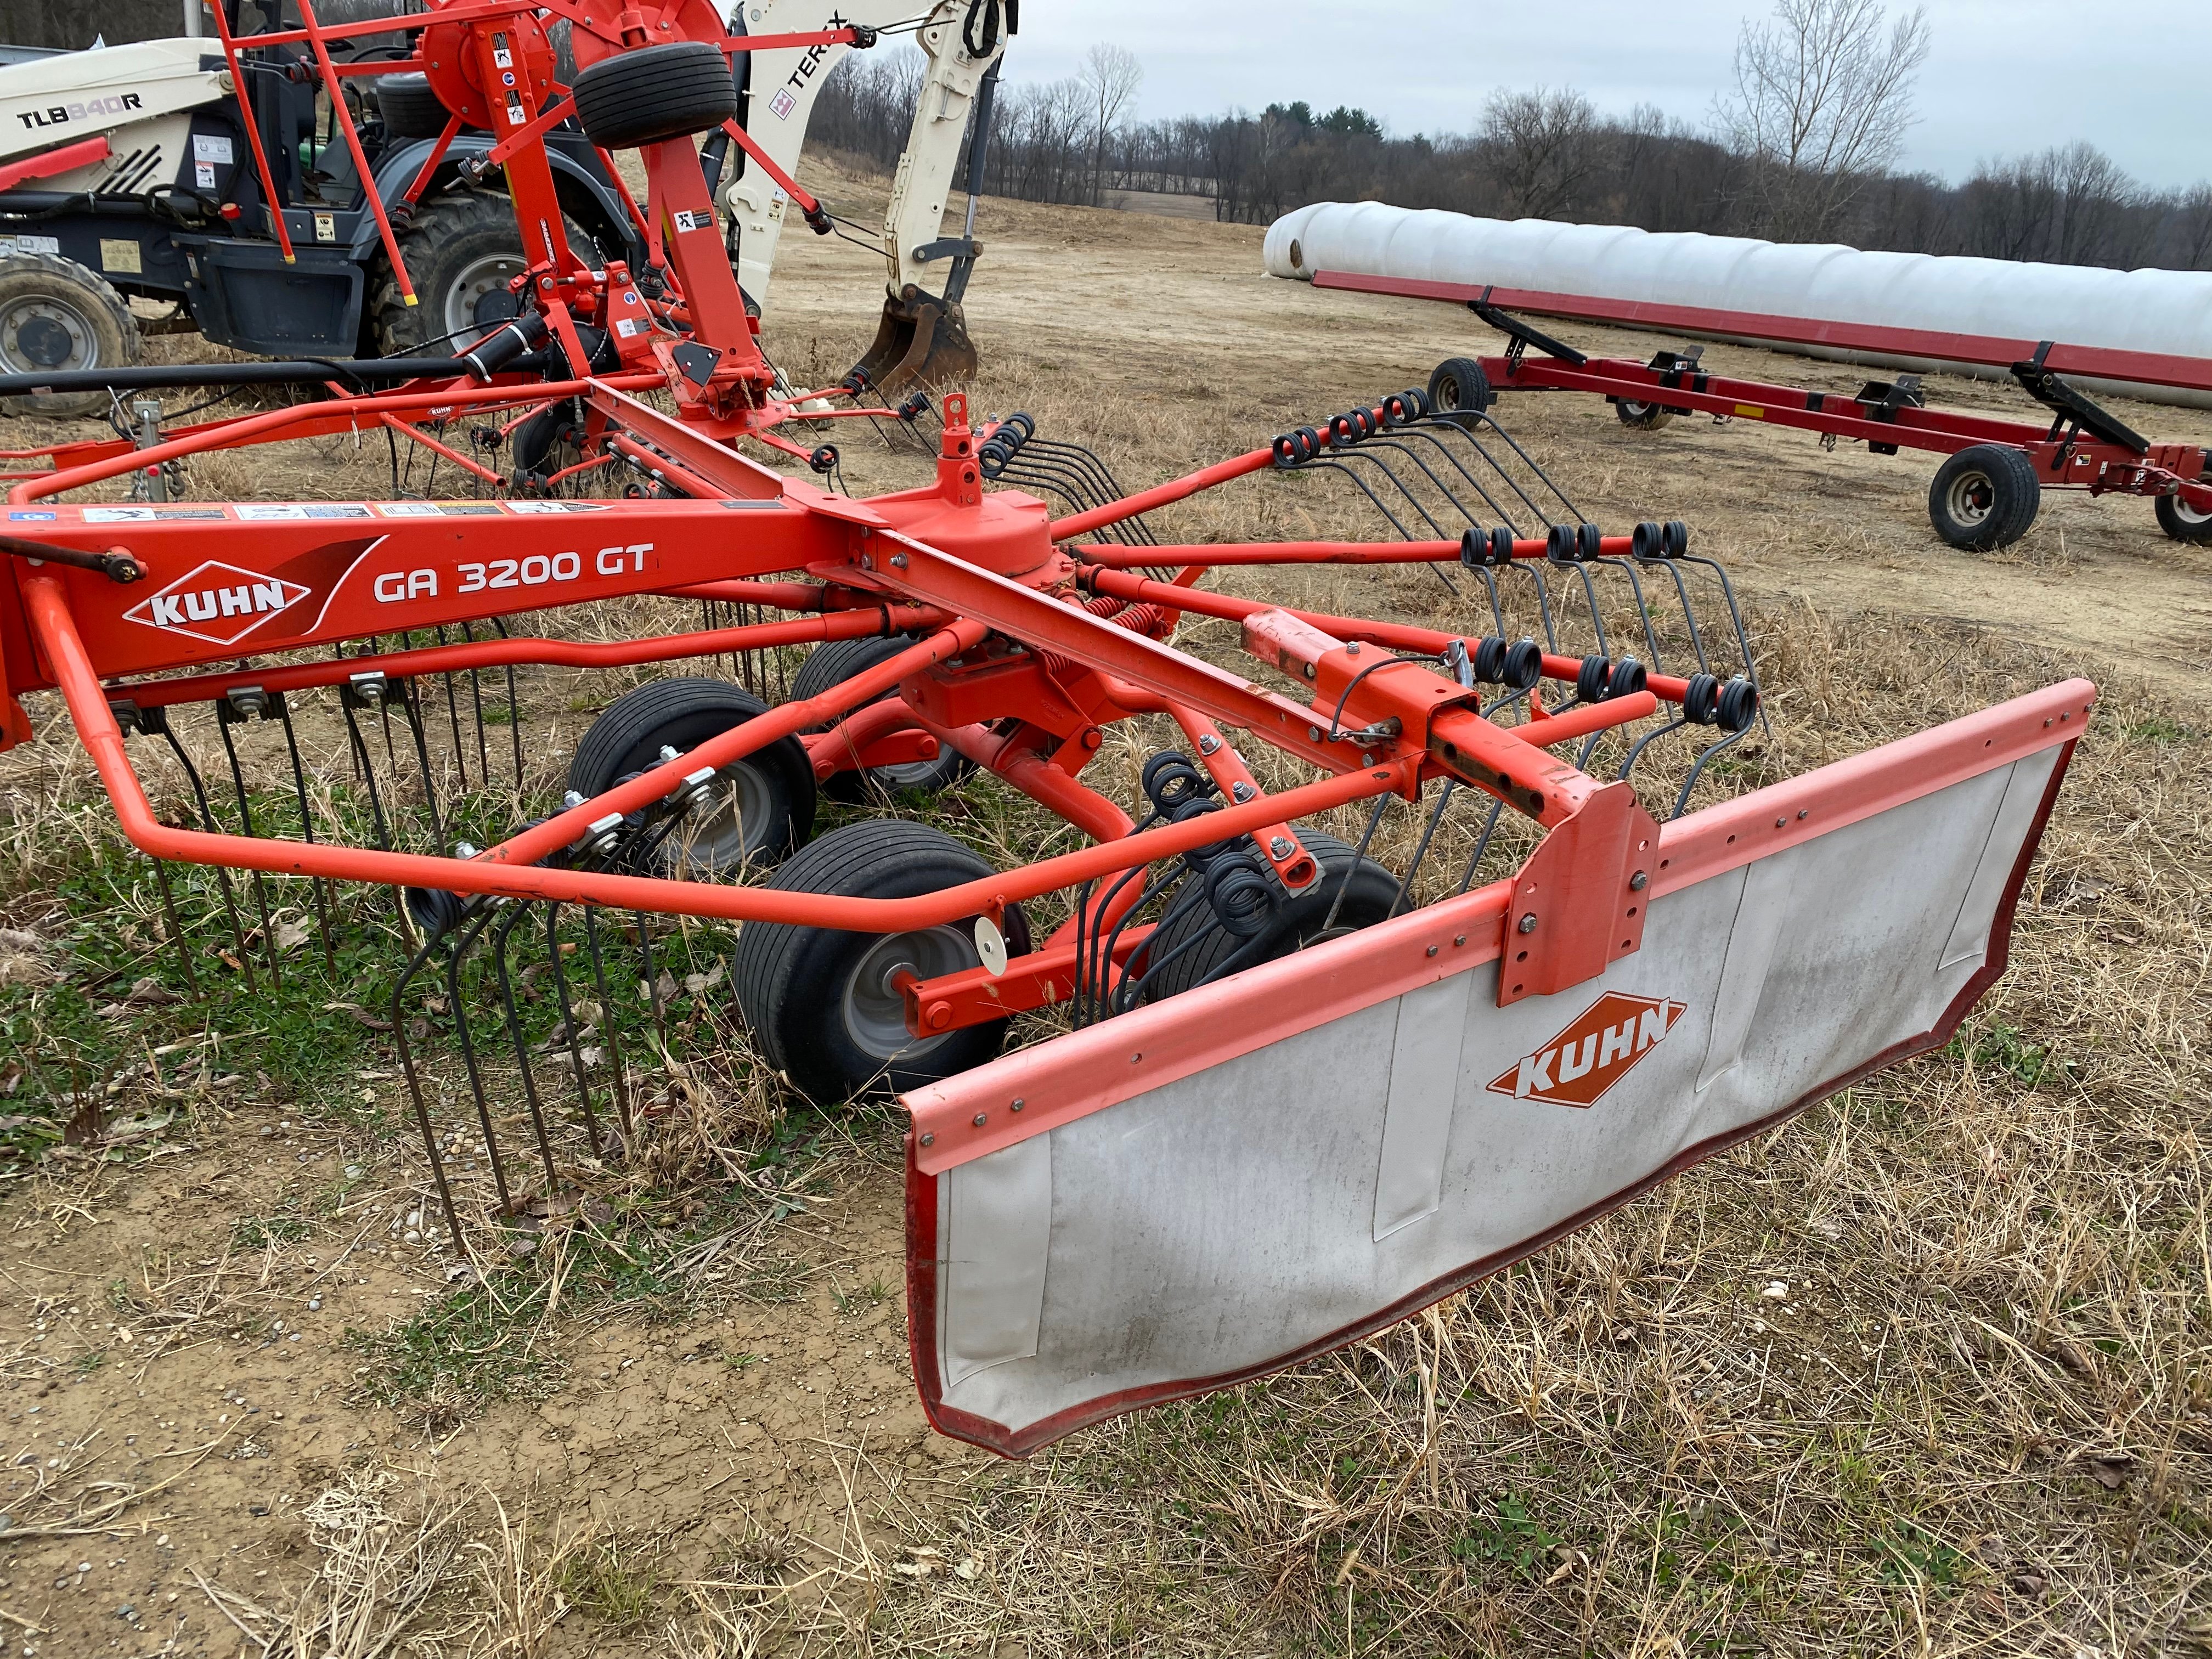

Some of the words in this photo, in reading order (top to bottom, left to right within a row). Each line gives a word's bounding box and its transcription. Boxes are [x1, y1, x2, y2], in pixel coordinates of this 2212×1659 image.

[787, 9, 849, 89] TERX
[16, 93, 143, 129] TLB840R
[431, 407, 450, 415] KUHN
[374, 568, 437, 602] GA
[458, 551, 580, 592] 3200
[596, 543, 654, 575] GT
[149, 580, 286, 626] KUHN
[1514, 997, 1670, 1099] KUHN
